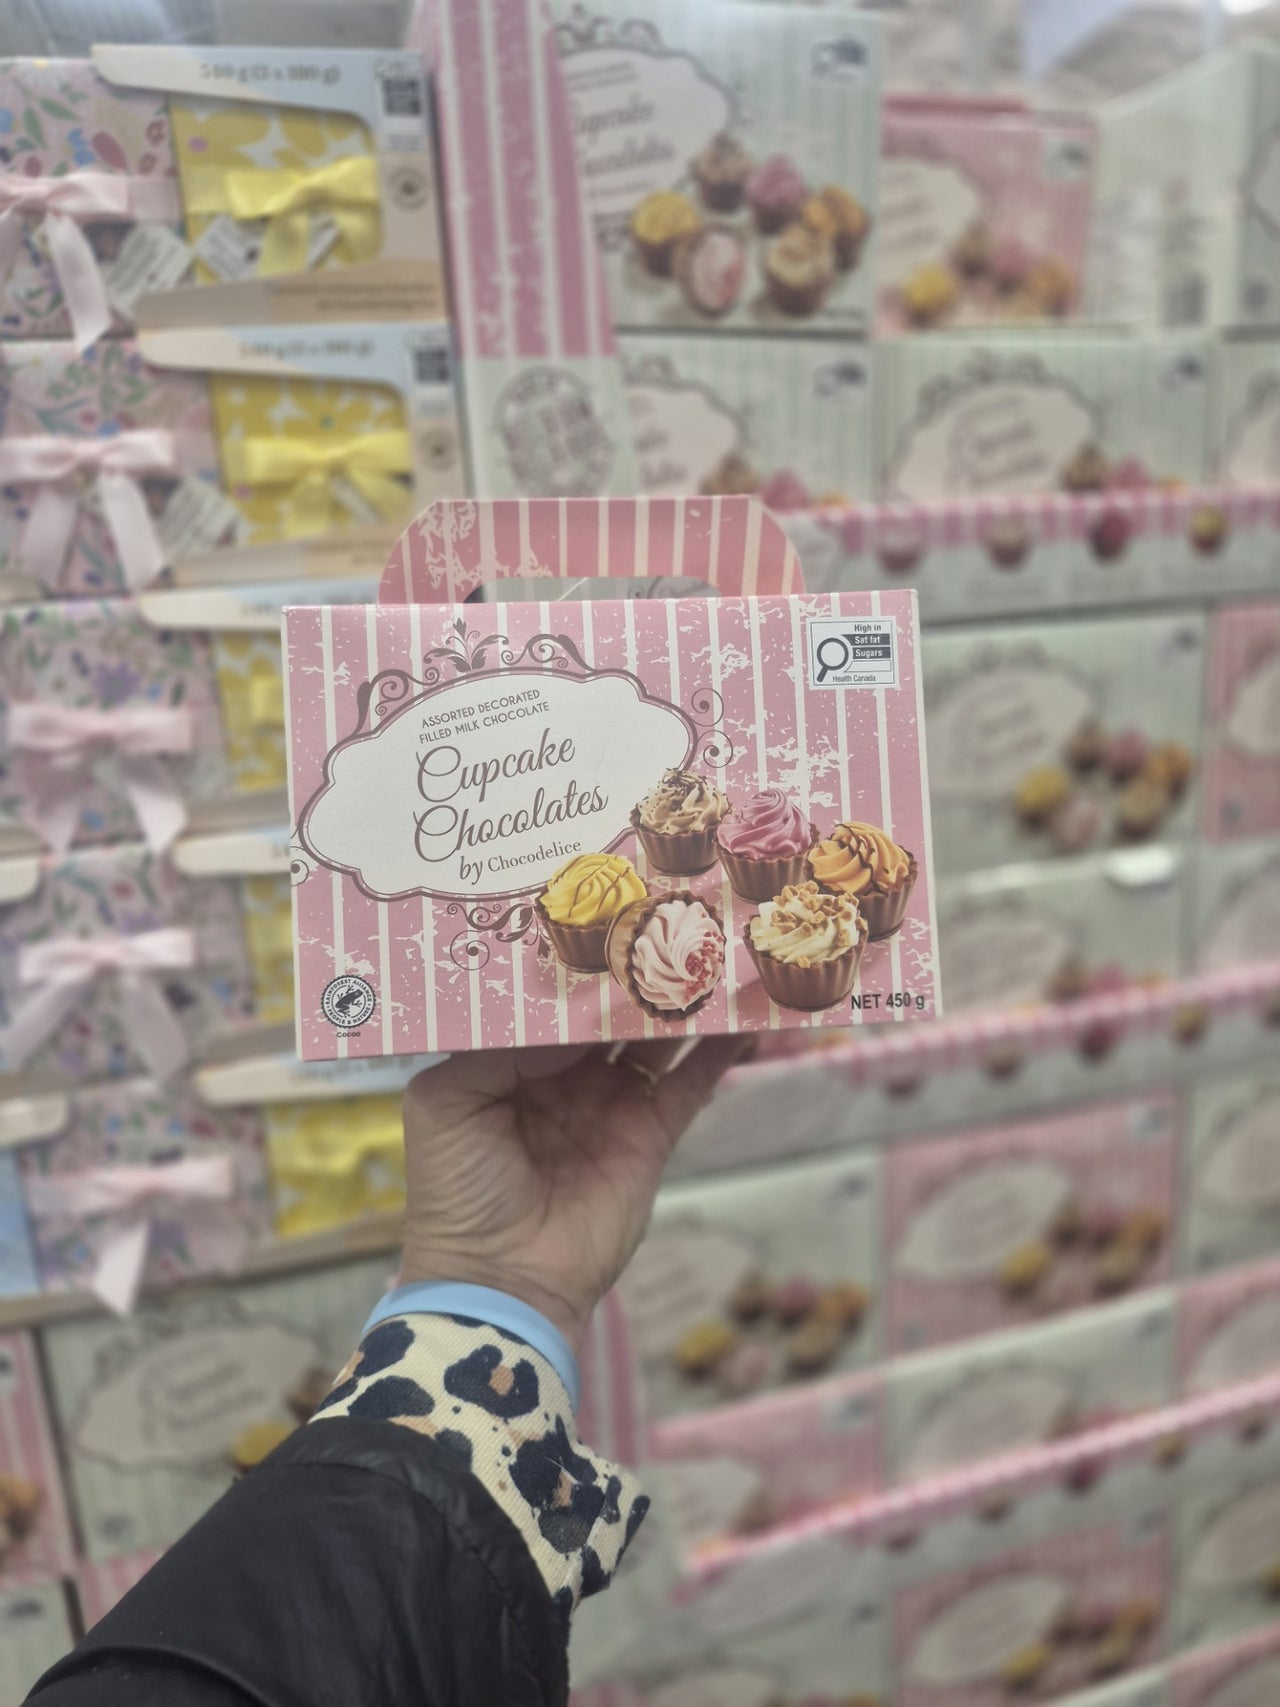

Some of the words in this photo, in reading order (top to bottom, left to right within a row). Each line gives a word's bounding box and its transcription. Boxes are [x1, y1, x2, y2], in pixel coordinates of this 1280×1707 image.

[854, 624, 872, 633] High
[874, 624, 881, 632] in
[854, 636, 868, 644] Sat
[869, 636, 881, 644] fat
[855, 649, 883, 659] Sugars
[832, 675, 852, 683] Health
[853, 674, 876, 682] Canada
[419, 728, 452, 744] FILLED
[455, 720, 480, 735] MILK
[483, 701, 550, 727] CHOCOLATE
[422, 706, 475, 729] ASSORTED
[478, 689, 540, 714] DECORATED
[416, 727, 576, 802] Cupcake
[413, 779, 609, 863] Chocolates
[459, 855, 483, 885] by
[487, 840, 582, 872] Chocodelice
[851, 994, 882, 1010] NET
[885, 992, 911, 1008] 450
[915, 995, 925, 1010] g
